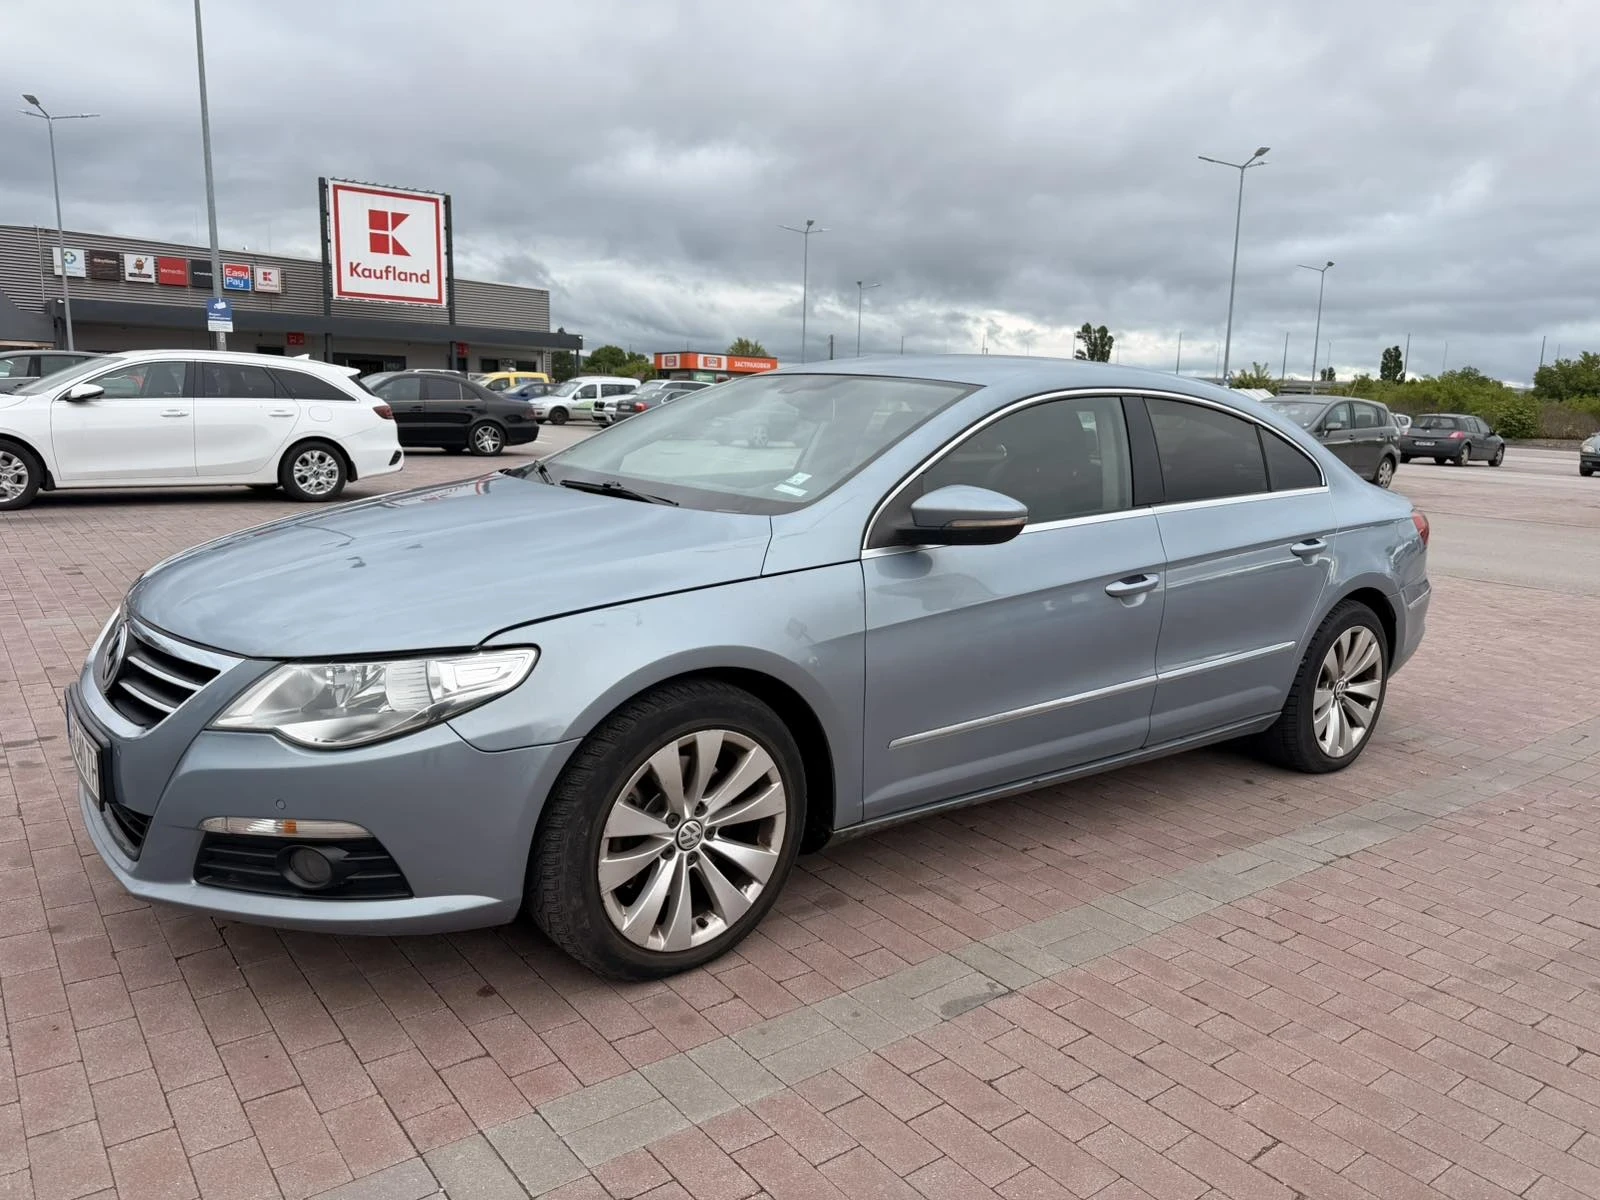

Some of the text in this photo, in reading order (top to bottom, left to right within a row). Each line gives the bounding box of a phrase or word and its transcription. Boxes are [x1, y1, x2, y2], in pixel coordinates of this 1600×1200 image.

[225, 268, 249, 280] Easy
[349, 262, 430, 284] Kaufland
[226, 277, 244, 287] Pay
